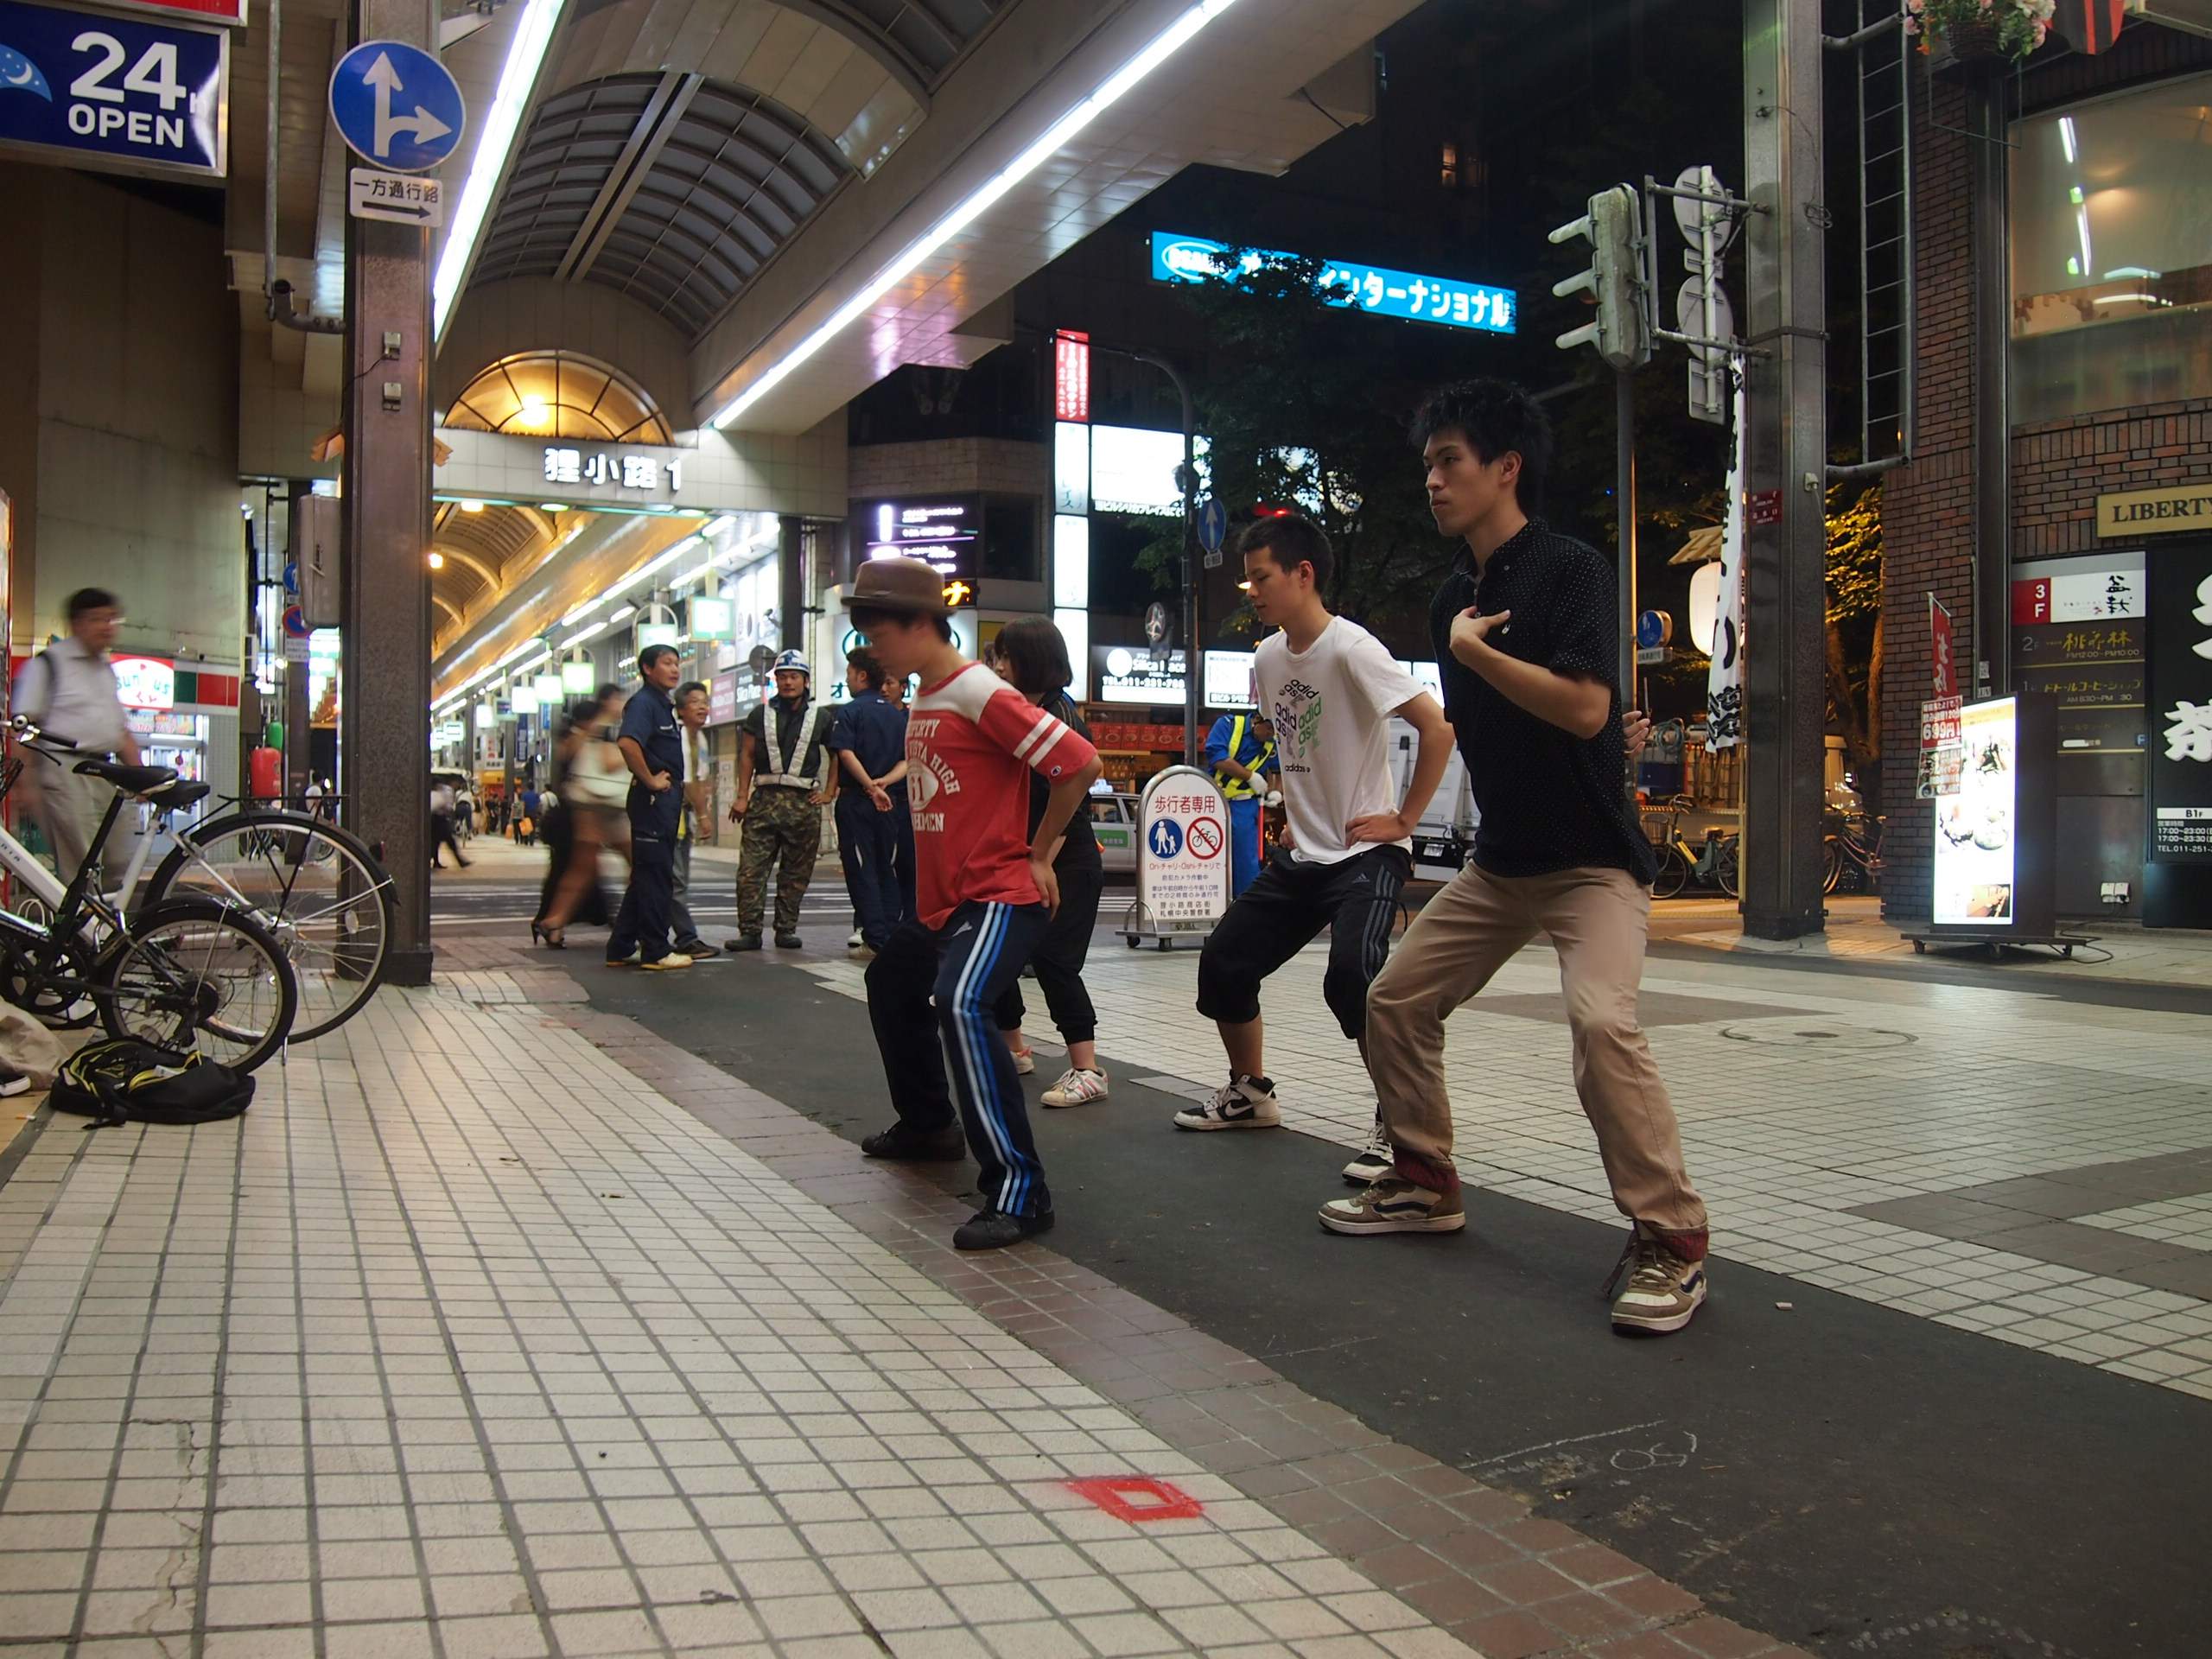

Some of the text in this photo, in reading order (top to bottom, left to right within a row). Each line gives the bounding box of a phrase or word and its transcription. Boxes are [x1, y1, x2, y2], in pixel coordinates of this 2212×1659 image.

[67, 103, 184, 149] OPEN
[353, 178, 439, 204] 一方通行路
[116, 672, 170, 696] sunus
[930, 753, 961, 796] HIGH
[1155, 795, 1216, 814] 歩行者専用
